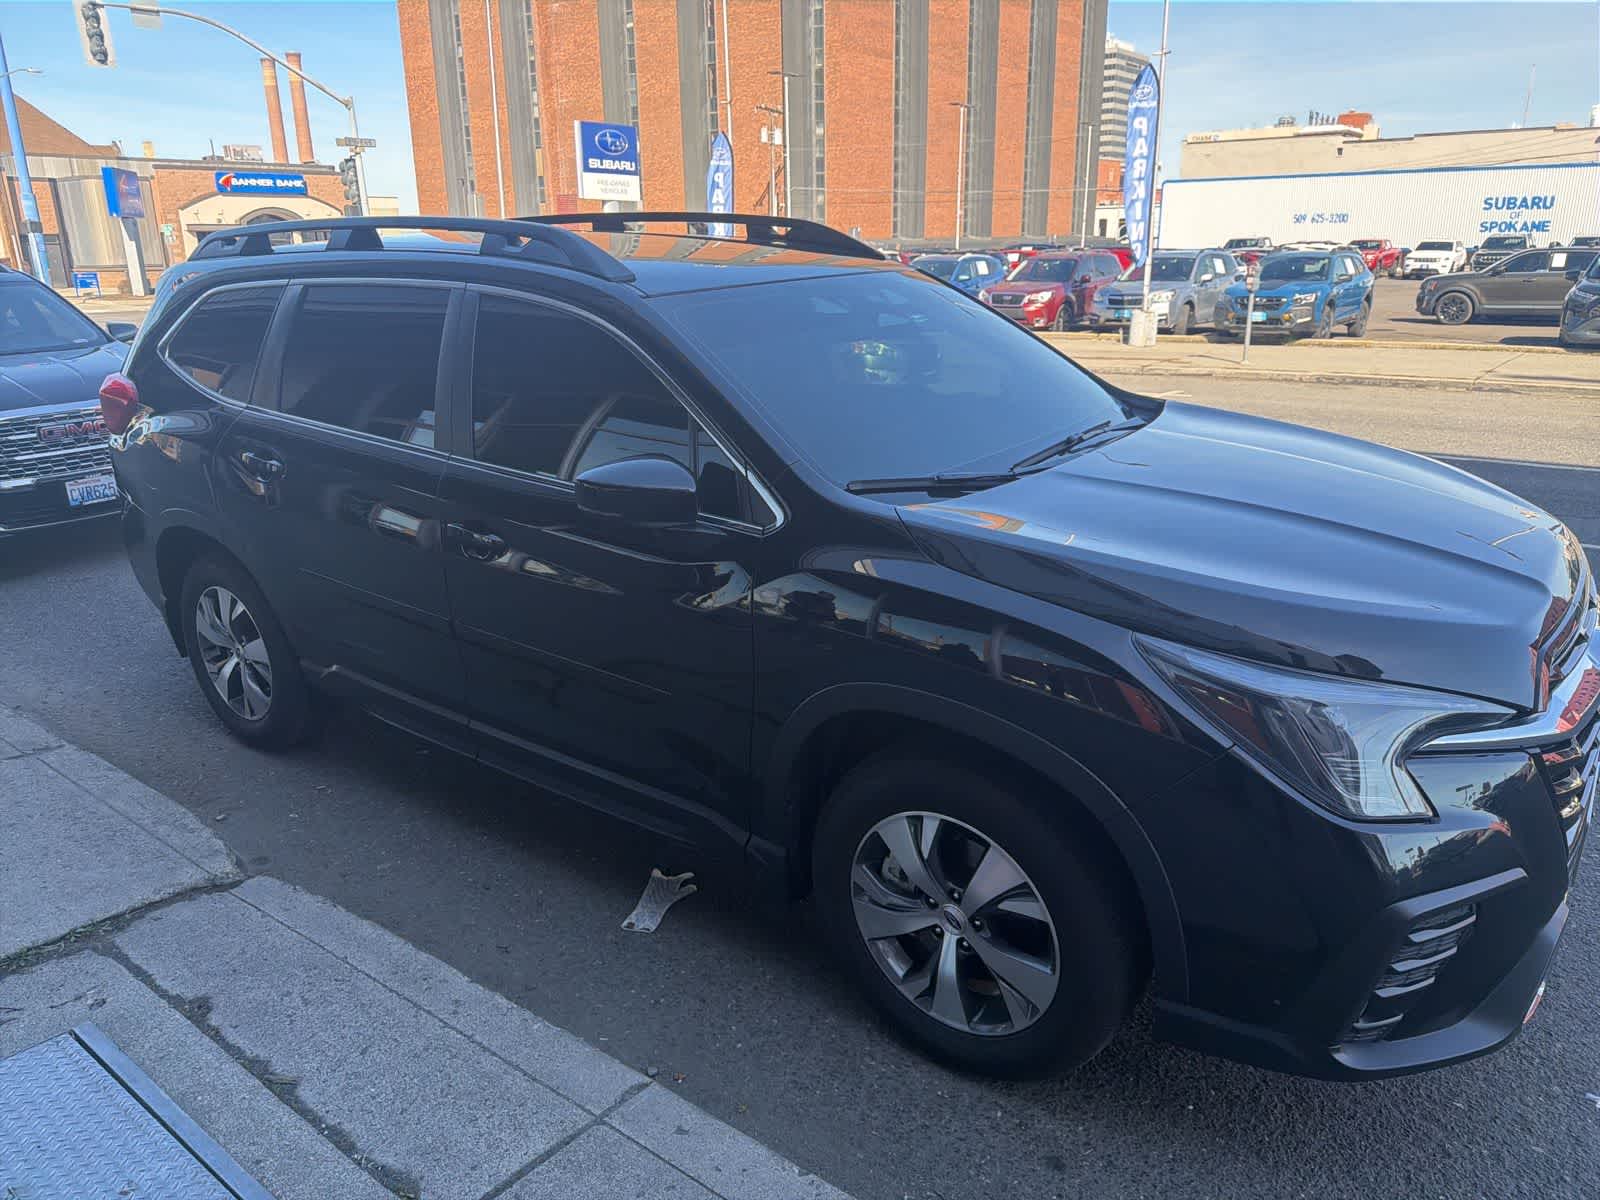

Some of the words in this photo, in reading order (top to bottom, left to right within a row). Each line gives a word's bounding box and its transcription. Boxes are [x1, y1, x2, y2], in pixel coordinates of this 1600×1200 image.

[588, 158, 636, 171] SUBARU
[231, 178, 272, 187] BANNER
[276, 179, 305, 188] BANK
[1482, 195, 1555, 211] SUBARU
[1293, 213, 1307, 225] 509
[1510, 211, 1524, 220] OF
[1479, 220, 1552, 233] SPOKANE
